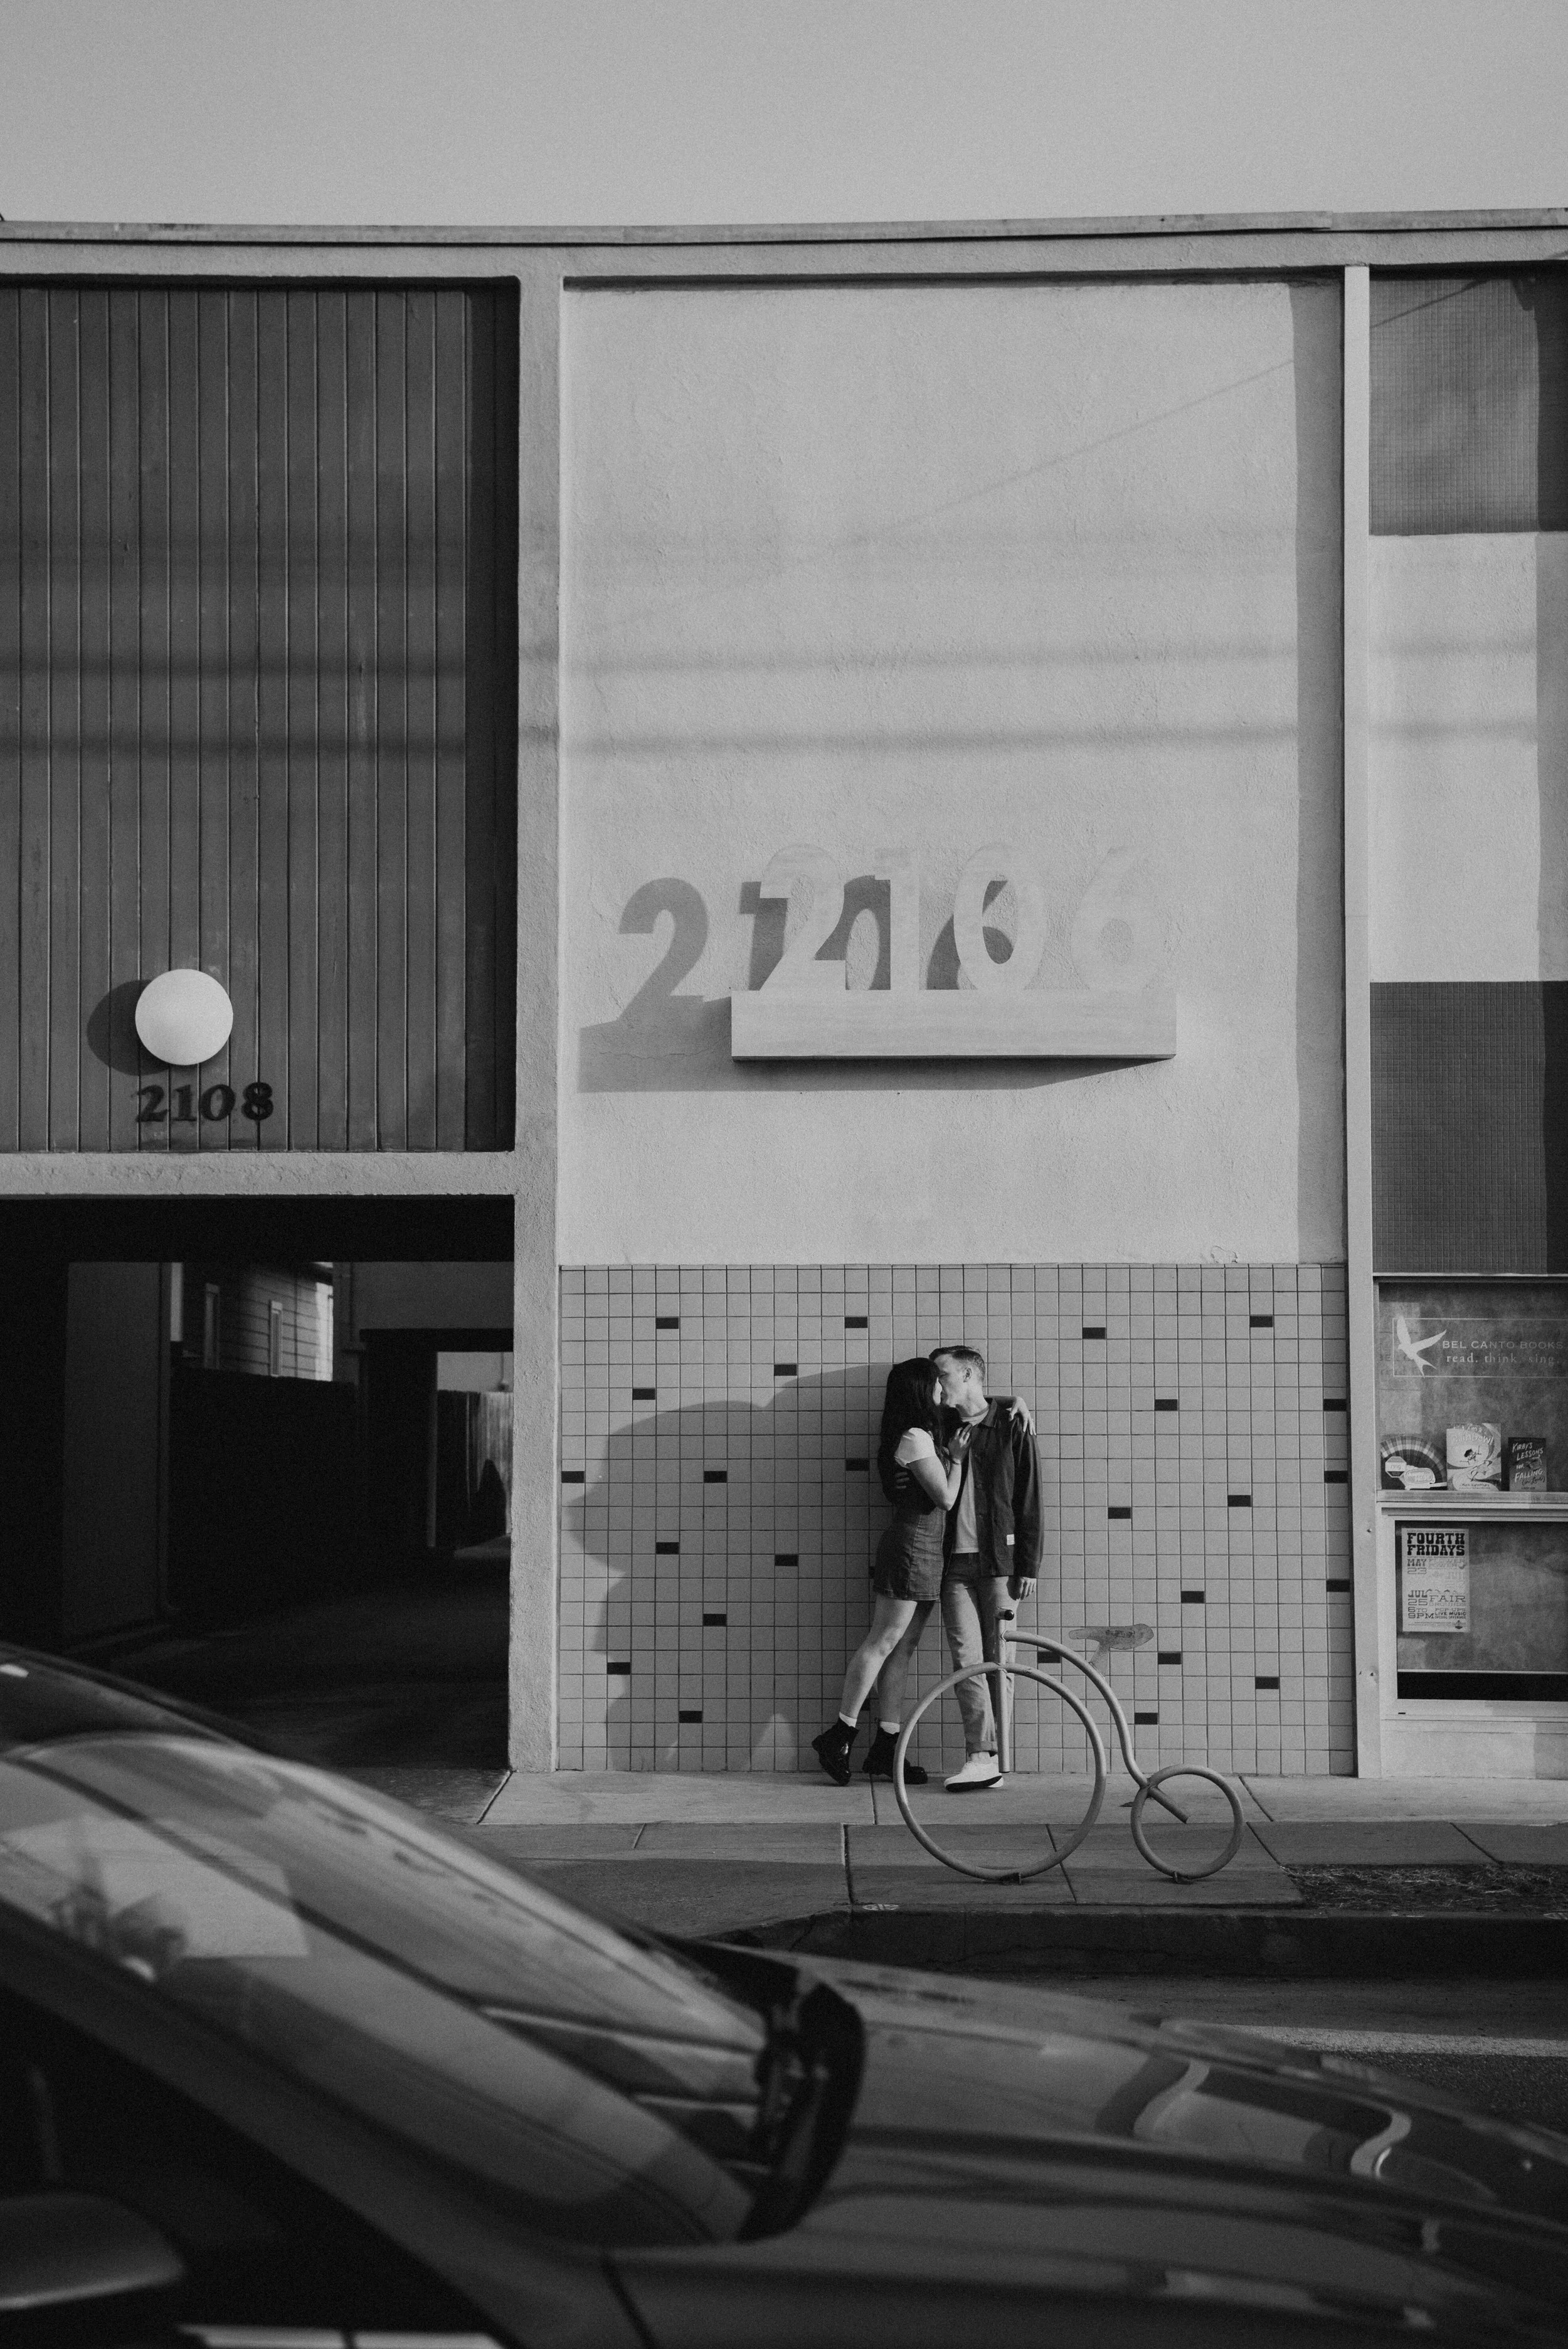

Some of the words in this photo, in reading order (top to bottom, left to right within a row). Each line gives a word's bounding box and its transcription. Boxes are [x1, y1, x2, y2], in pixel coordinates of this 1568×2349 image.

[760, 842, 1162, 990] 2106
[136, 1082, 274, 1122] 2108
[1443, 1340, 1466, 1349] BEL
[1471, 1340, 1515, 1349] CANTO
[1520, 1341, 1563, 1349] BOOKS
[1447, 1352, 1478, 1362] read.
[1517, 1447, 1544, 1461] LESSONS
[1515, 1468, 1544, 1483] FALLING
[1407, 1532, 1465, 1545] FOURTH
[1407, 1544, 1465, 1556] FRIDAYS
[1407, 1559, 1427, 1567] MAY
[1408, 1590, 1428, 1598] JUL
